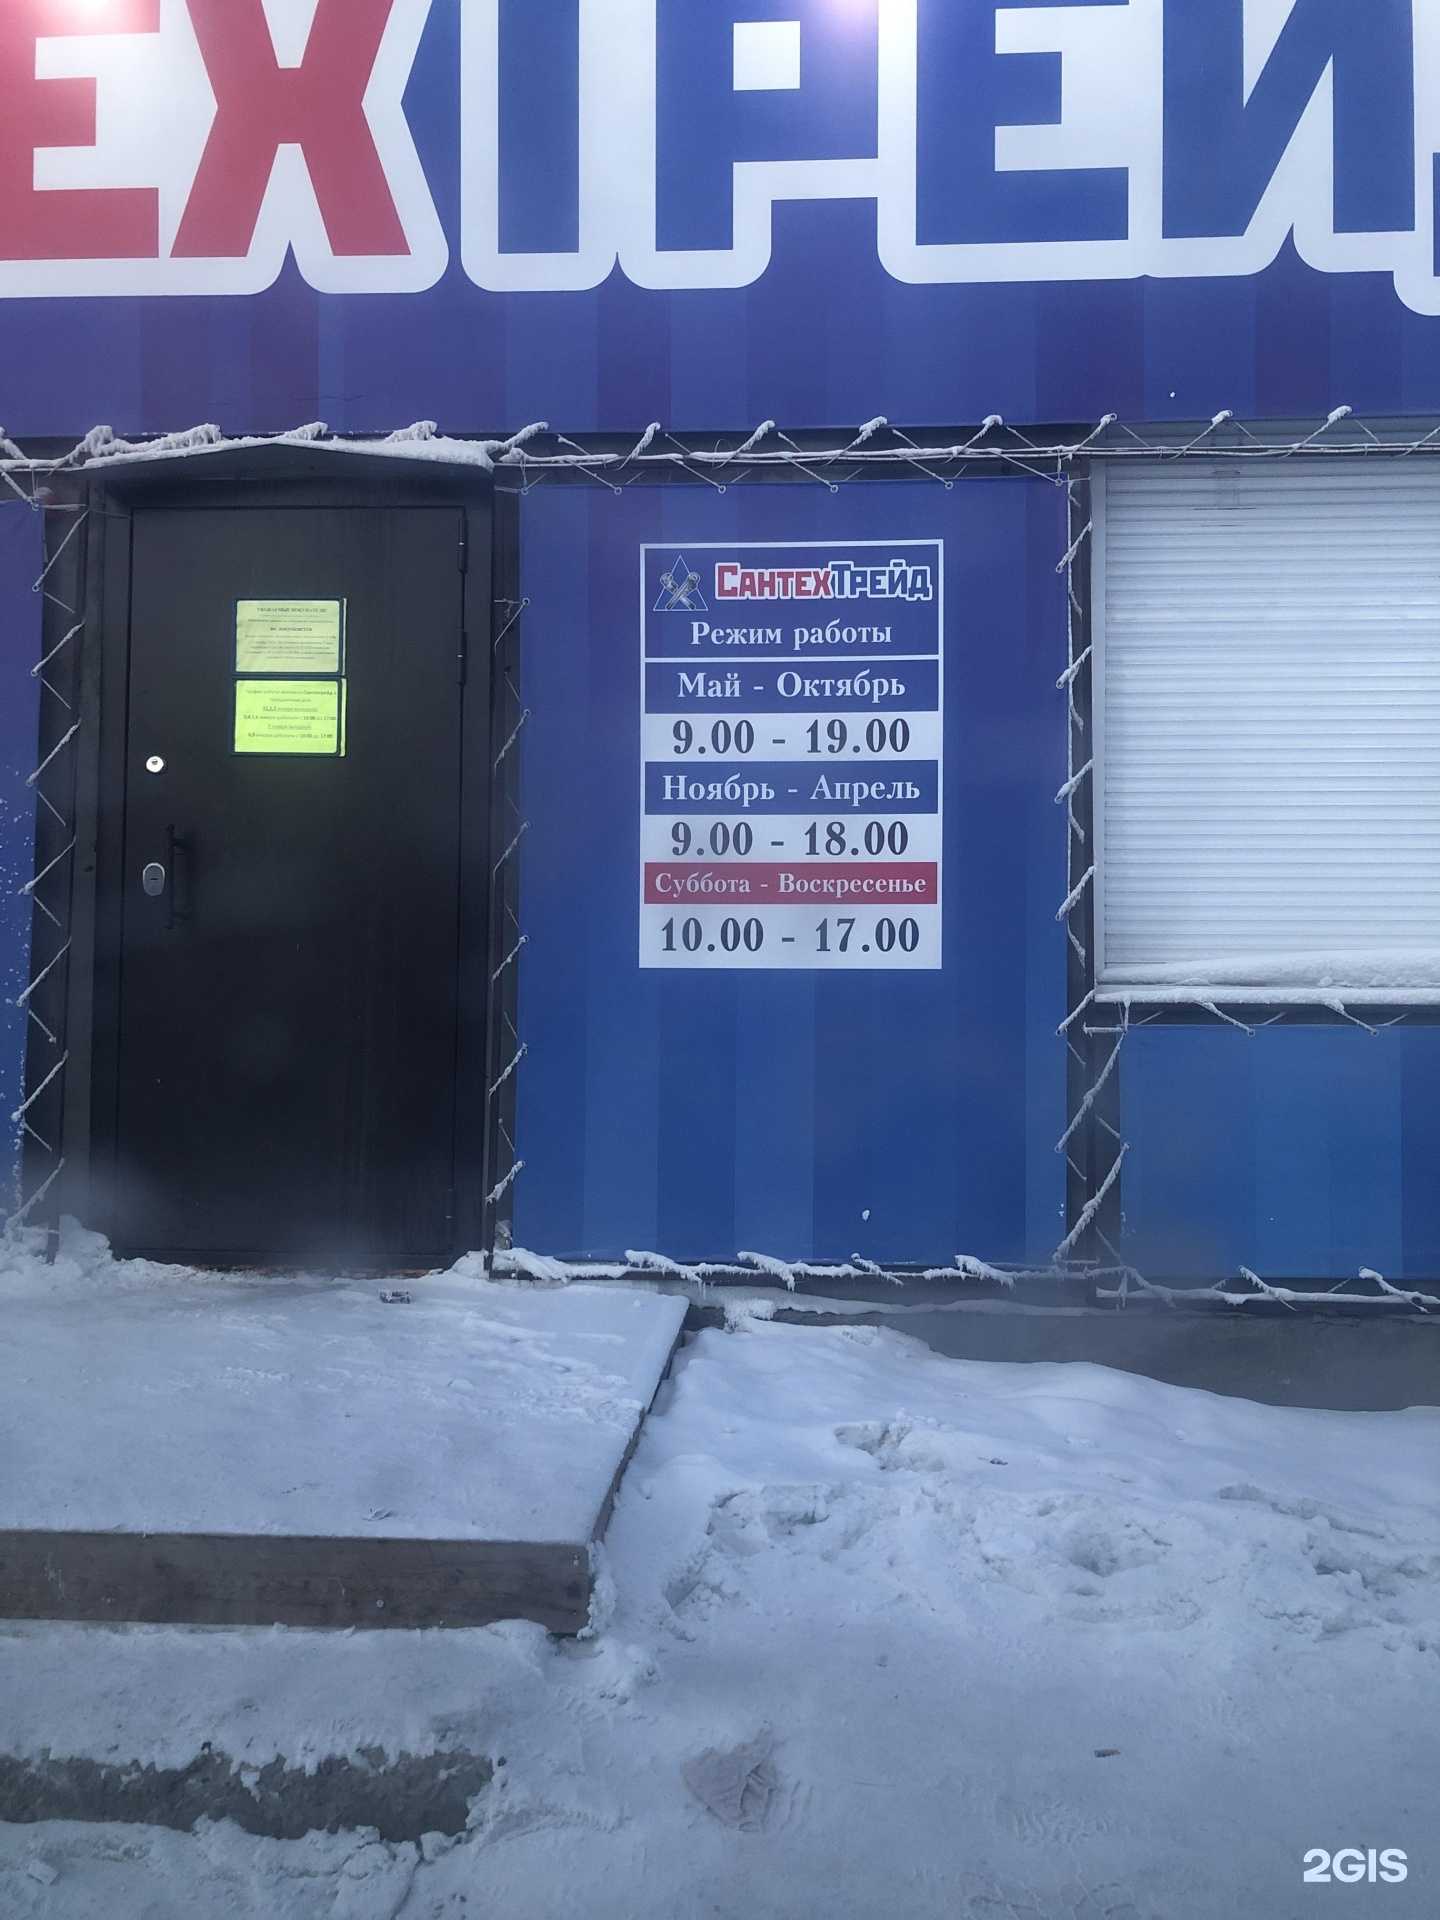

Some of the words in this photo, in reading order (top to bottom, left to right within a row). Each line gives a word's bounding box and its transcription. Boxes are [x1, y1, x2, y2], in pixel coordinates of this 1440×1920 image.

[690, 621, 783, 646] Режим
[793, 618, 892, 650] работы
[677, 672, 742, 698] Май
[776, 669, 906, 703] Октябрь
[672, 719, 755, 754] 9.00
[805, 718, 910, 754] 19.00
[662, 773, 775, 807] Ноябрь
[809, 774, 921, 806] Апрель
[671, 821, 753, 856] 9.00
[804, 820, 909, 856] 18.00
[655, 872, 751, 898] Суббота
[777, 873, 927, 898] Воскресенье
[661, 917, 764, 952] 10.00
[815, 917, 920, 952] 17.00
